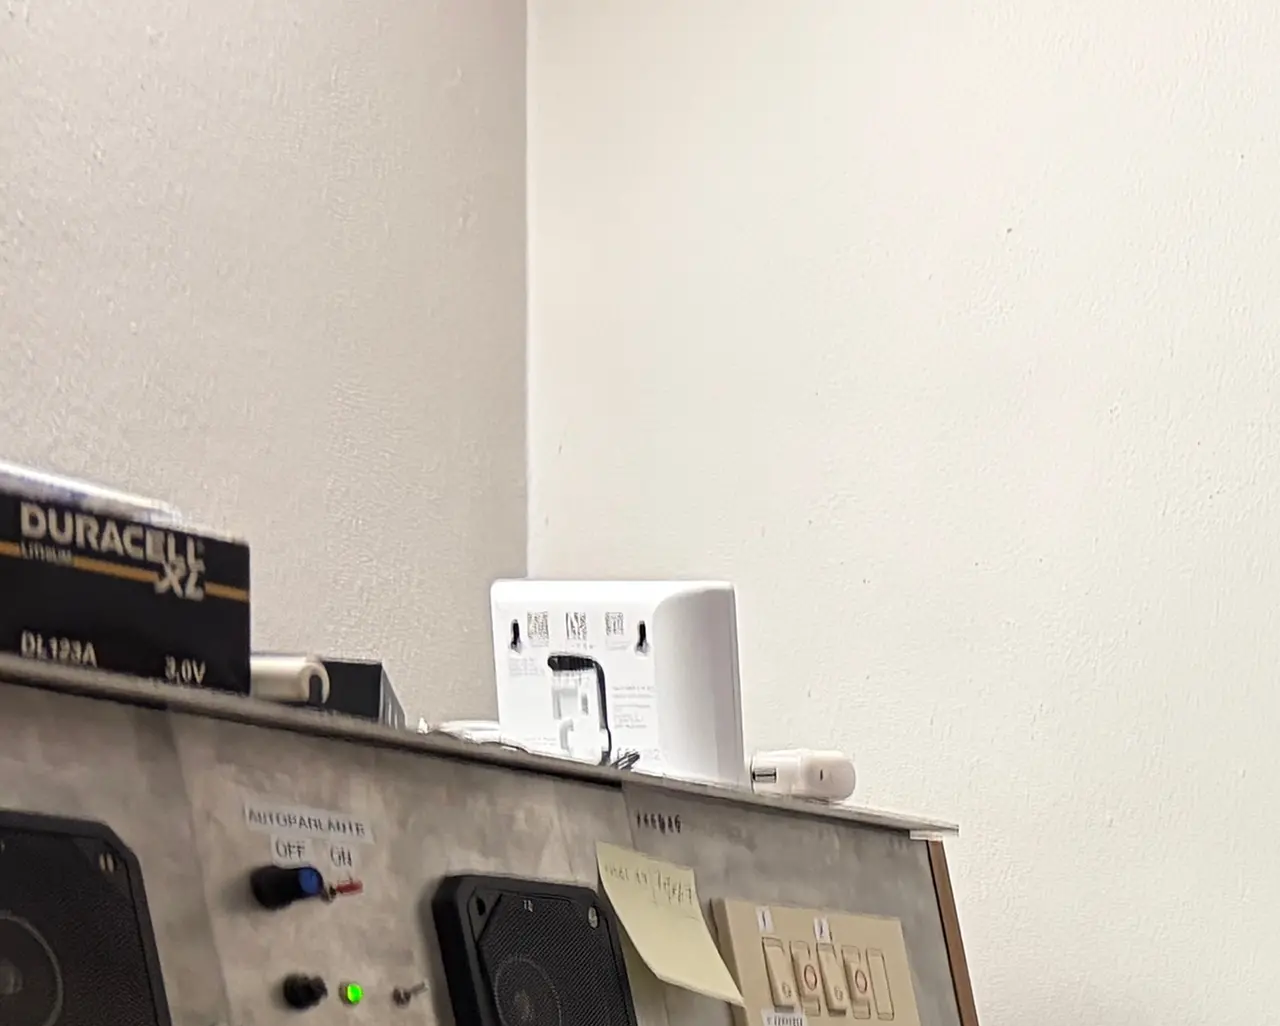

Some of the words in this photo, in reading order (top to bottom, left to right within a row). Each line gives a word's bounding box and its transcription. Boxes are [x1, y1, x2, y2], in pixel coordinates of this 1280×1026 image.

[20, 501, 205, 568] DURACELL
[154, 556, 206, 602] XL
[275, 838, 306, 860] OFF
[329, 845, 353, 868] ON
